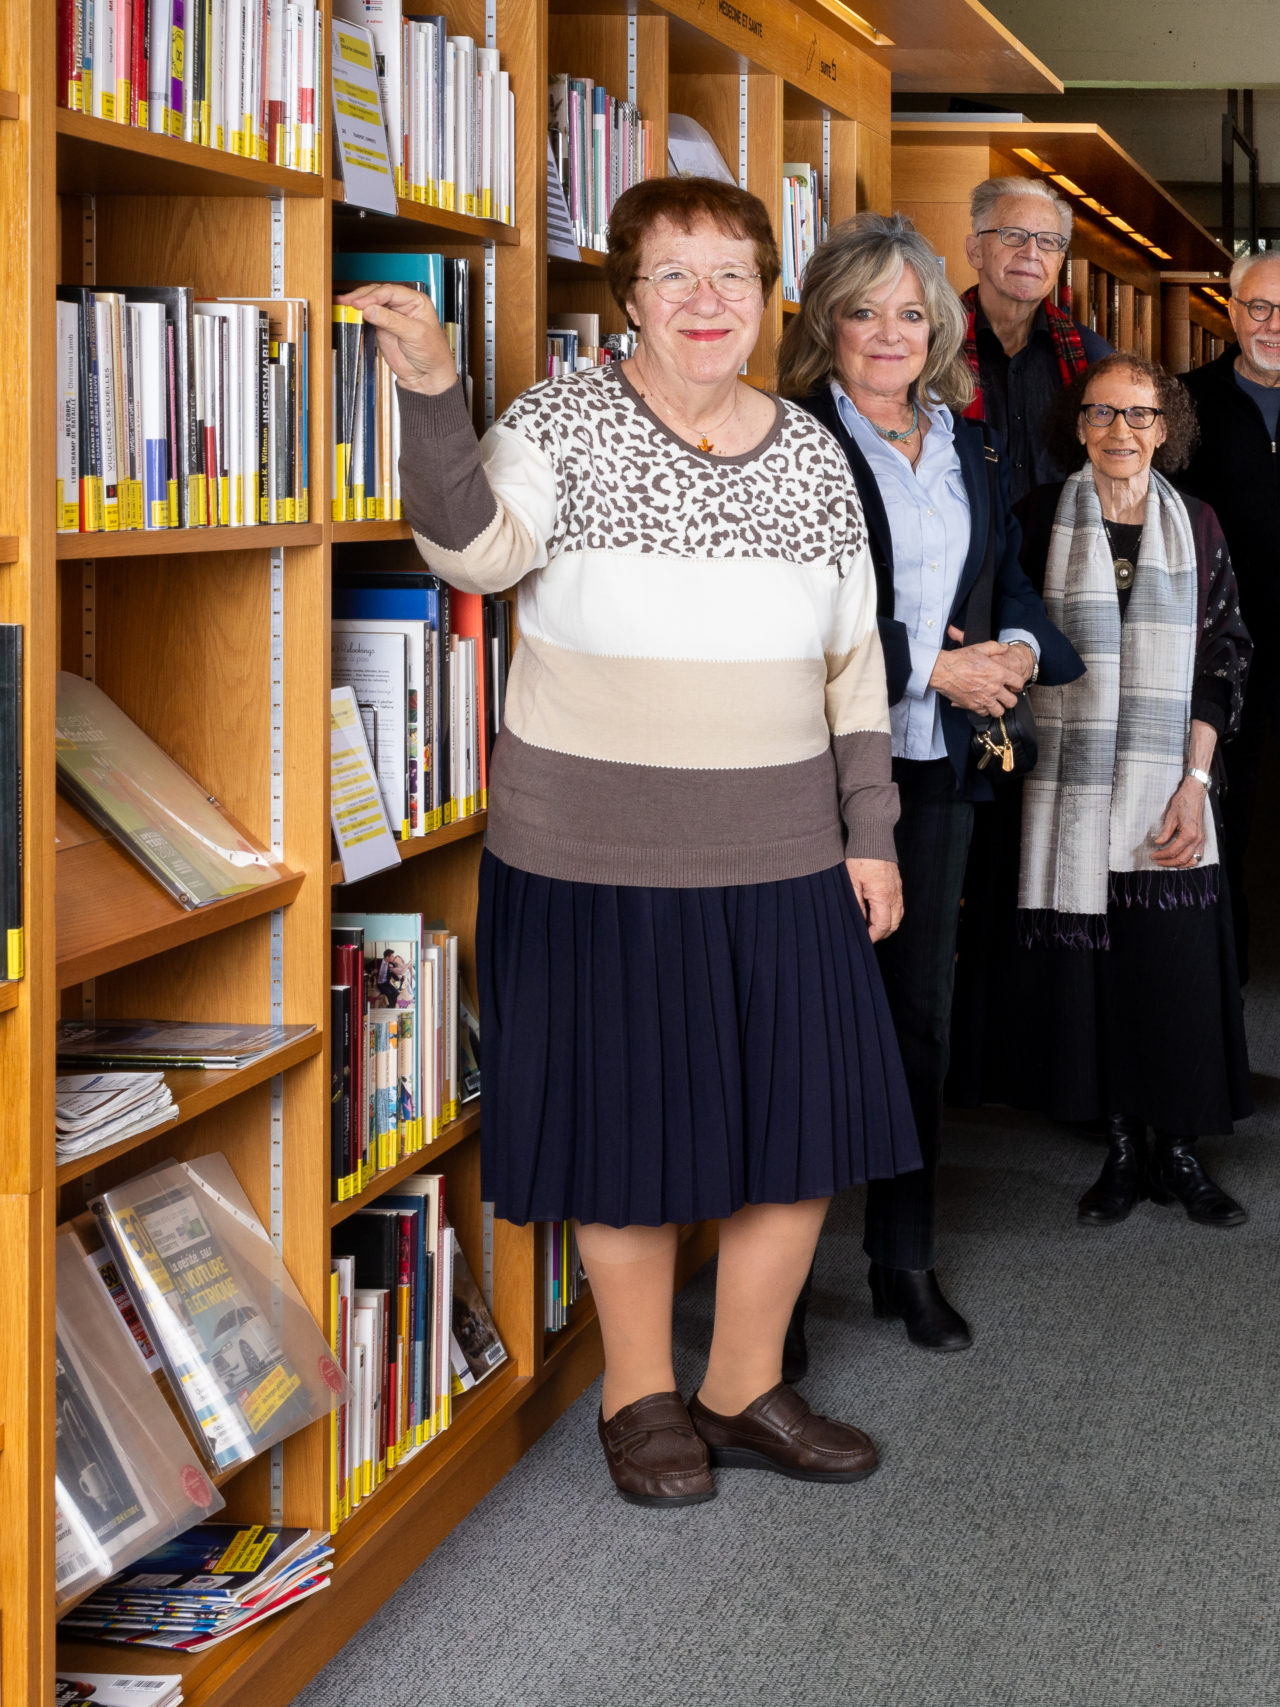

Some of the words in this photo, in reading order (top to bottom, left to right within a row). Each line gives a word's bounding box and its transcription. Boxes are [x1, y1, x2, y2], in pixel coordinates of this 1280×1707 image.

[820, 60, 831, 78] SUITE
[262, 332, 270, 423] INESTIMABLE
[260, 466, 268, 474] K.
[169, 1262, 178, 1273] la
[199, 1246, 212, 1258] sur
[184, 1256, 229, 1289] VOITURE
